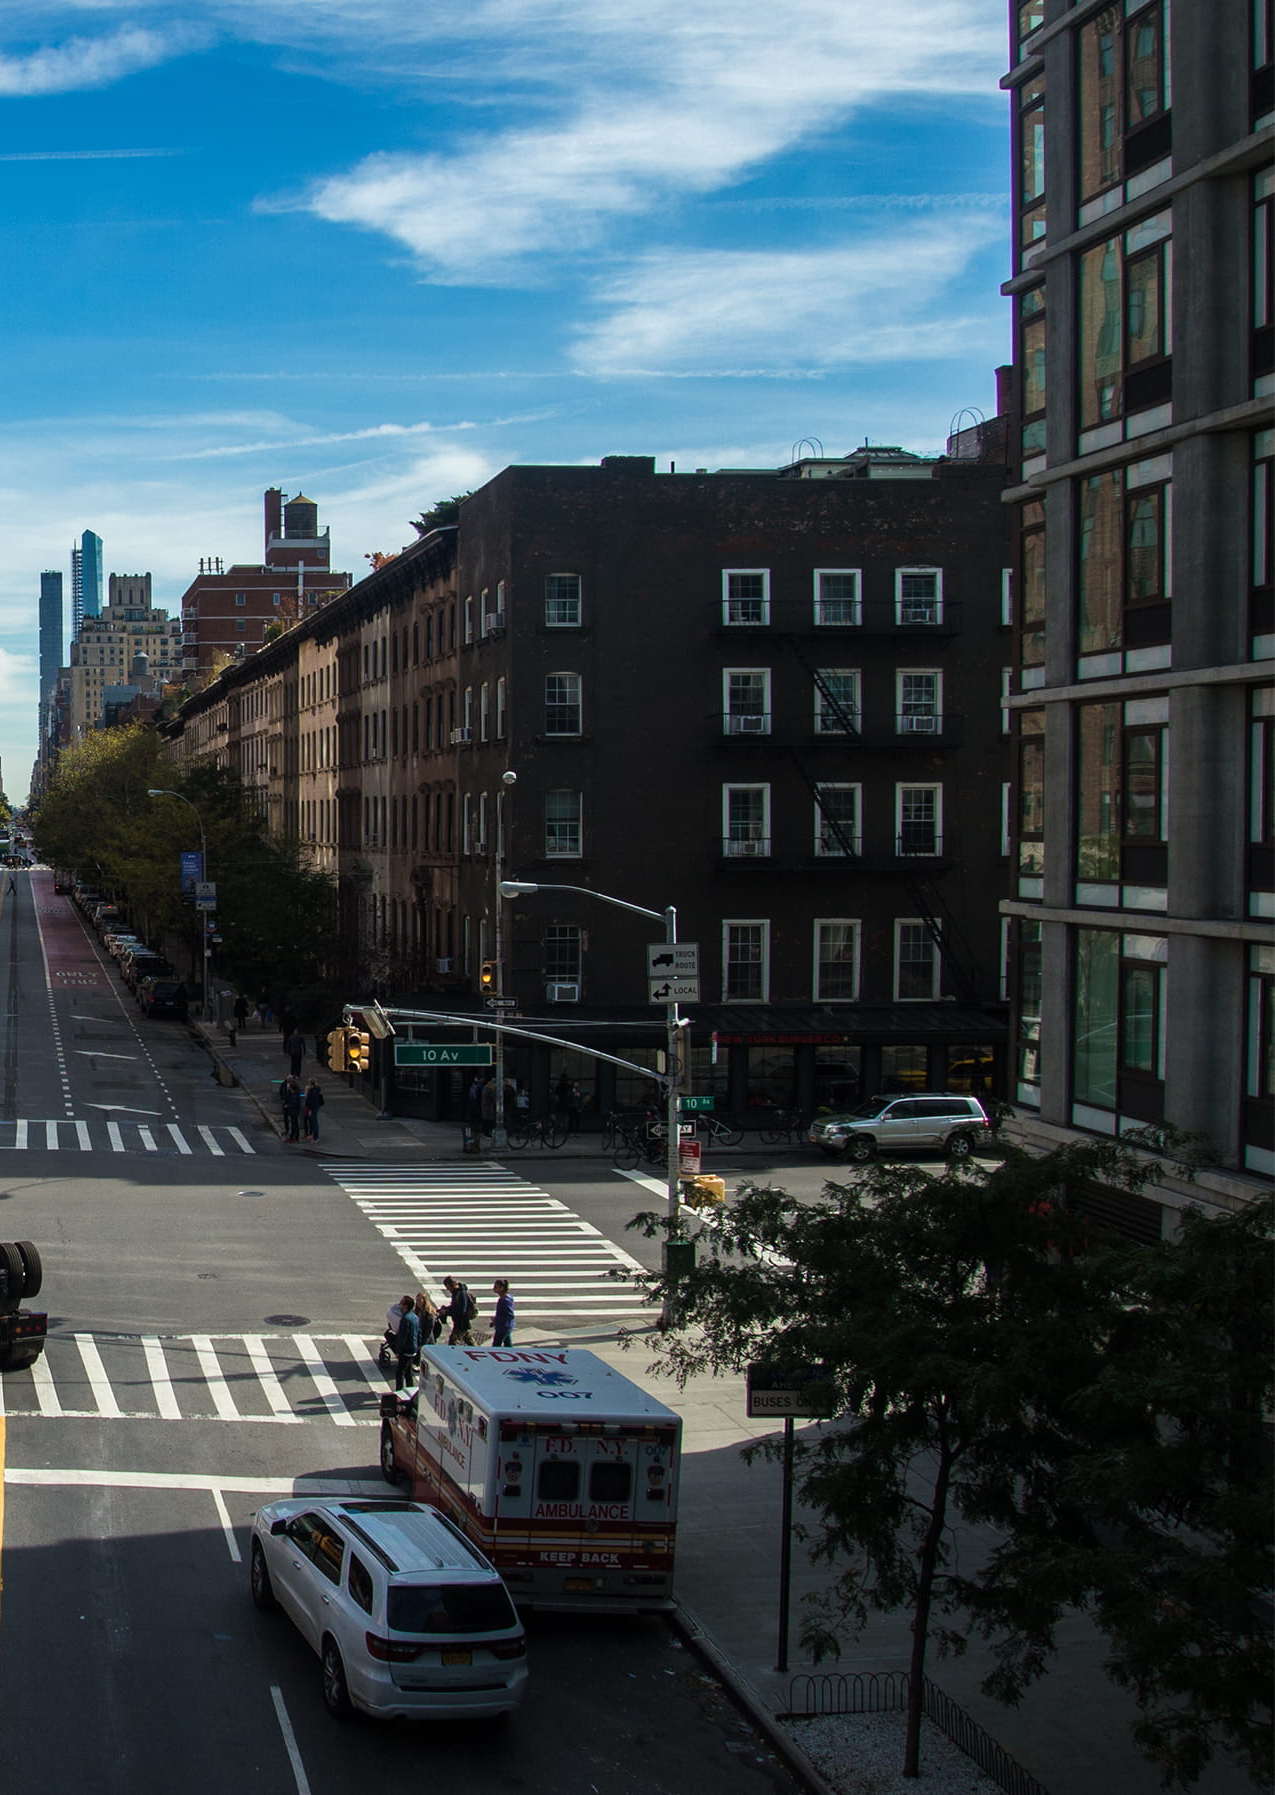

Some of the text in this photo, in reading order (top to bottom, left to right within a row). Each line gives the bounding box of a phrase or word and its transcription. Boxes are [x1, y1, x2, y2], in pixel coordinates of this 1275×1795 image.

[746, 1035, 776, 1044] YORK
[422, 1050, 459, 1061] 10 Av
[686, 1099, 697, 1109] 10
[463, 1350, 569, 1365] FDNY
[536, 1391, 593, 1399] 007
[754, 1396, 791, 1407] BUSES
[545, 1439, 628, 1455] F.D. N.Y.
[645, 1445, 668, 1456] 007
[535, 1503, 629, 1519] AMBULANCE
[540, 1552, 620, 1564] KEEP BACK
